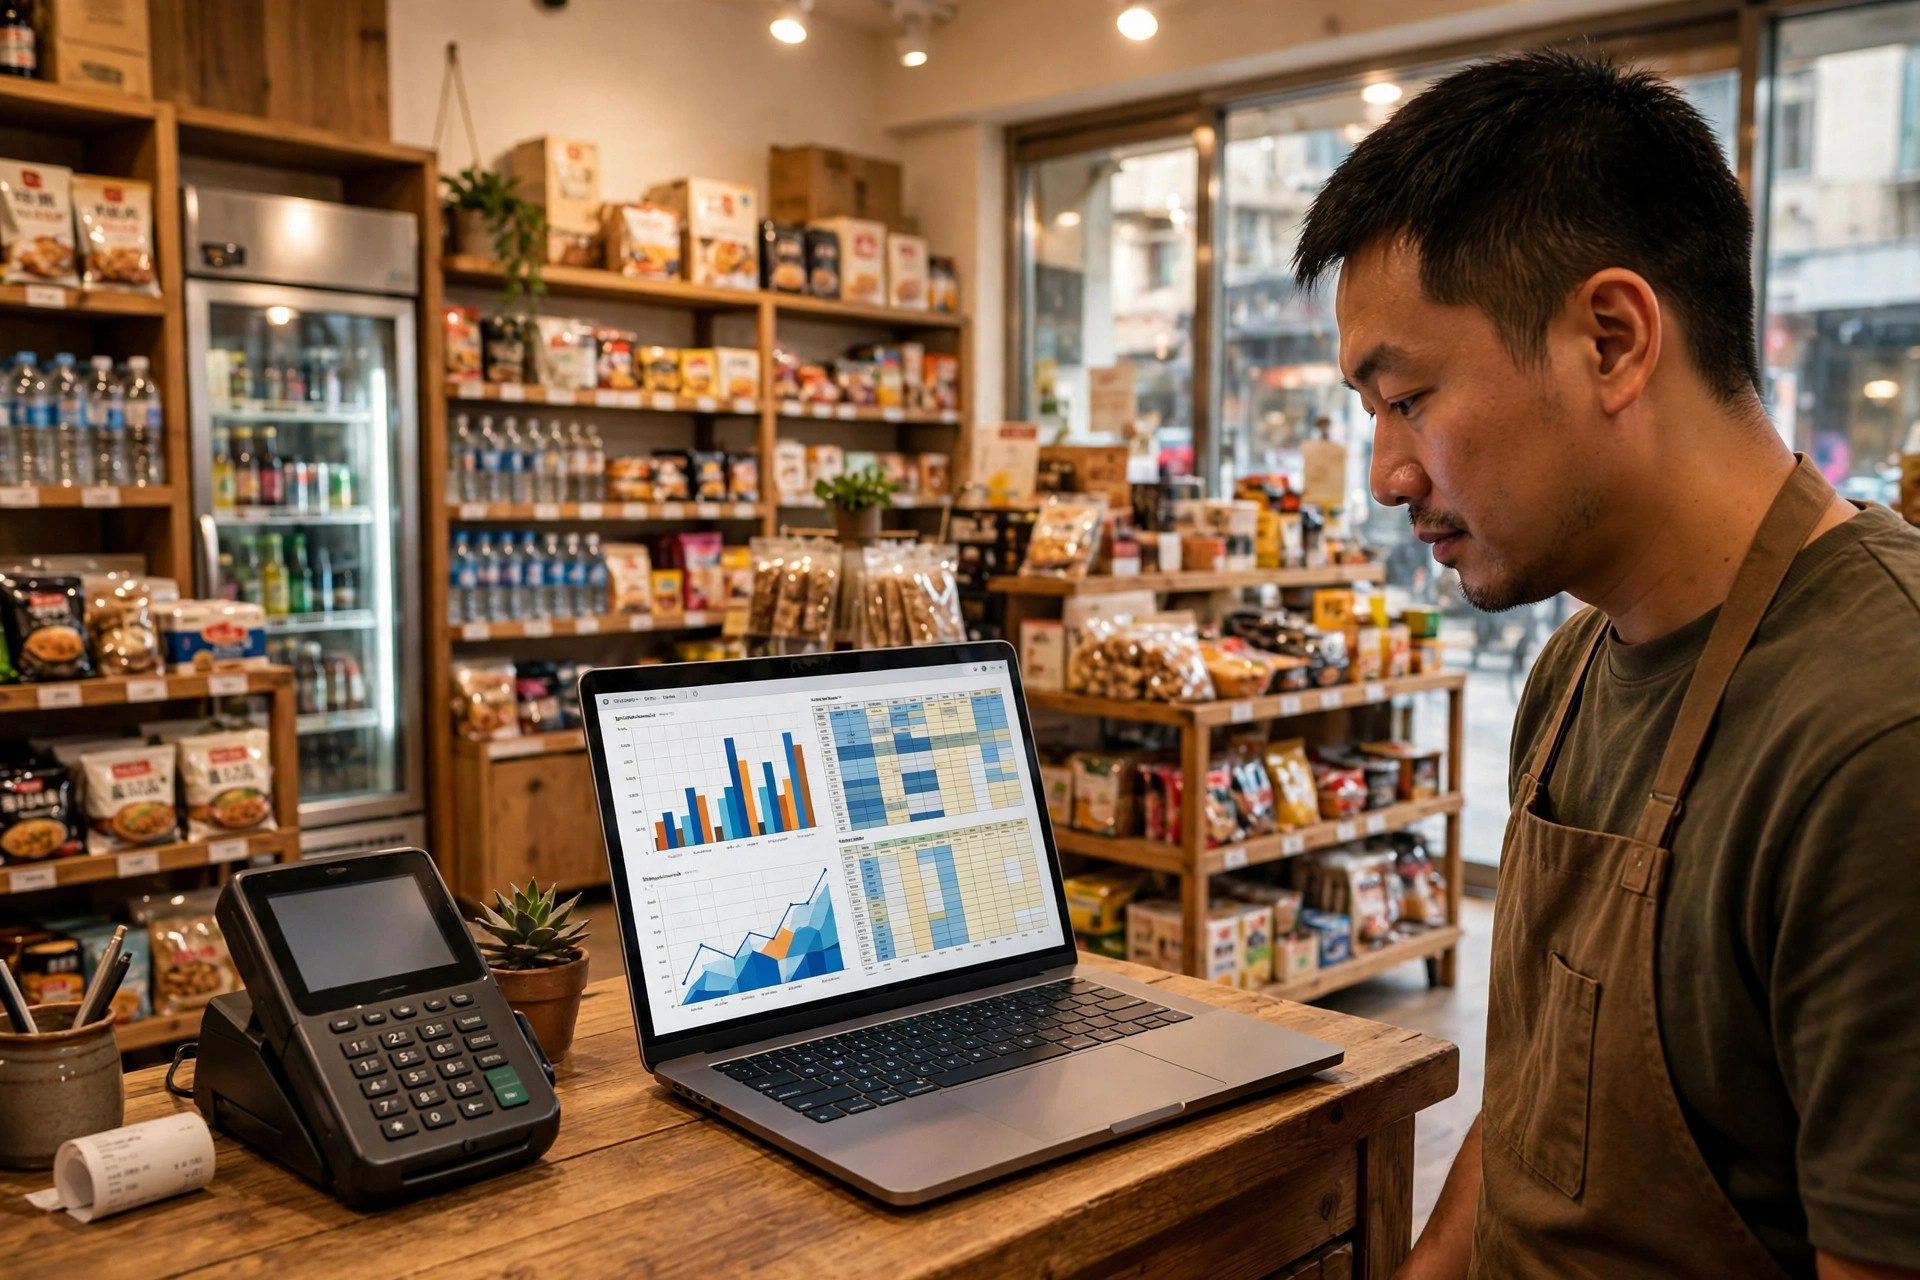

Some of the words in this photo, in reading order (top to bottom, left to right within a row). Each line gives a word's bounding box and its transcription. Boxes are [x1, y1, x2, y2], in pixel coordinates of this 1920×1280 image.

[425, 1025, 436, 1035] 3
[388, 1033, 399, 1044] 2
[351, 1041, 359, 1052] 1
[436, 1044, 446, 1054] 6
[399, 1051, 409, 1062] 5
[360, 1061, 369, 1071] 1
[408, 1071, 419, 1082] 5
[370, 1081, 381, 1091] 4
[456, 1082, 467, 1093] 9
[419, 1091, 430, 1103] 8
[379, 1100, 389, 1112] 7
[430, 1112, 441, 1122] 0
